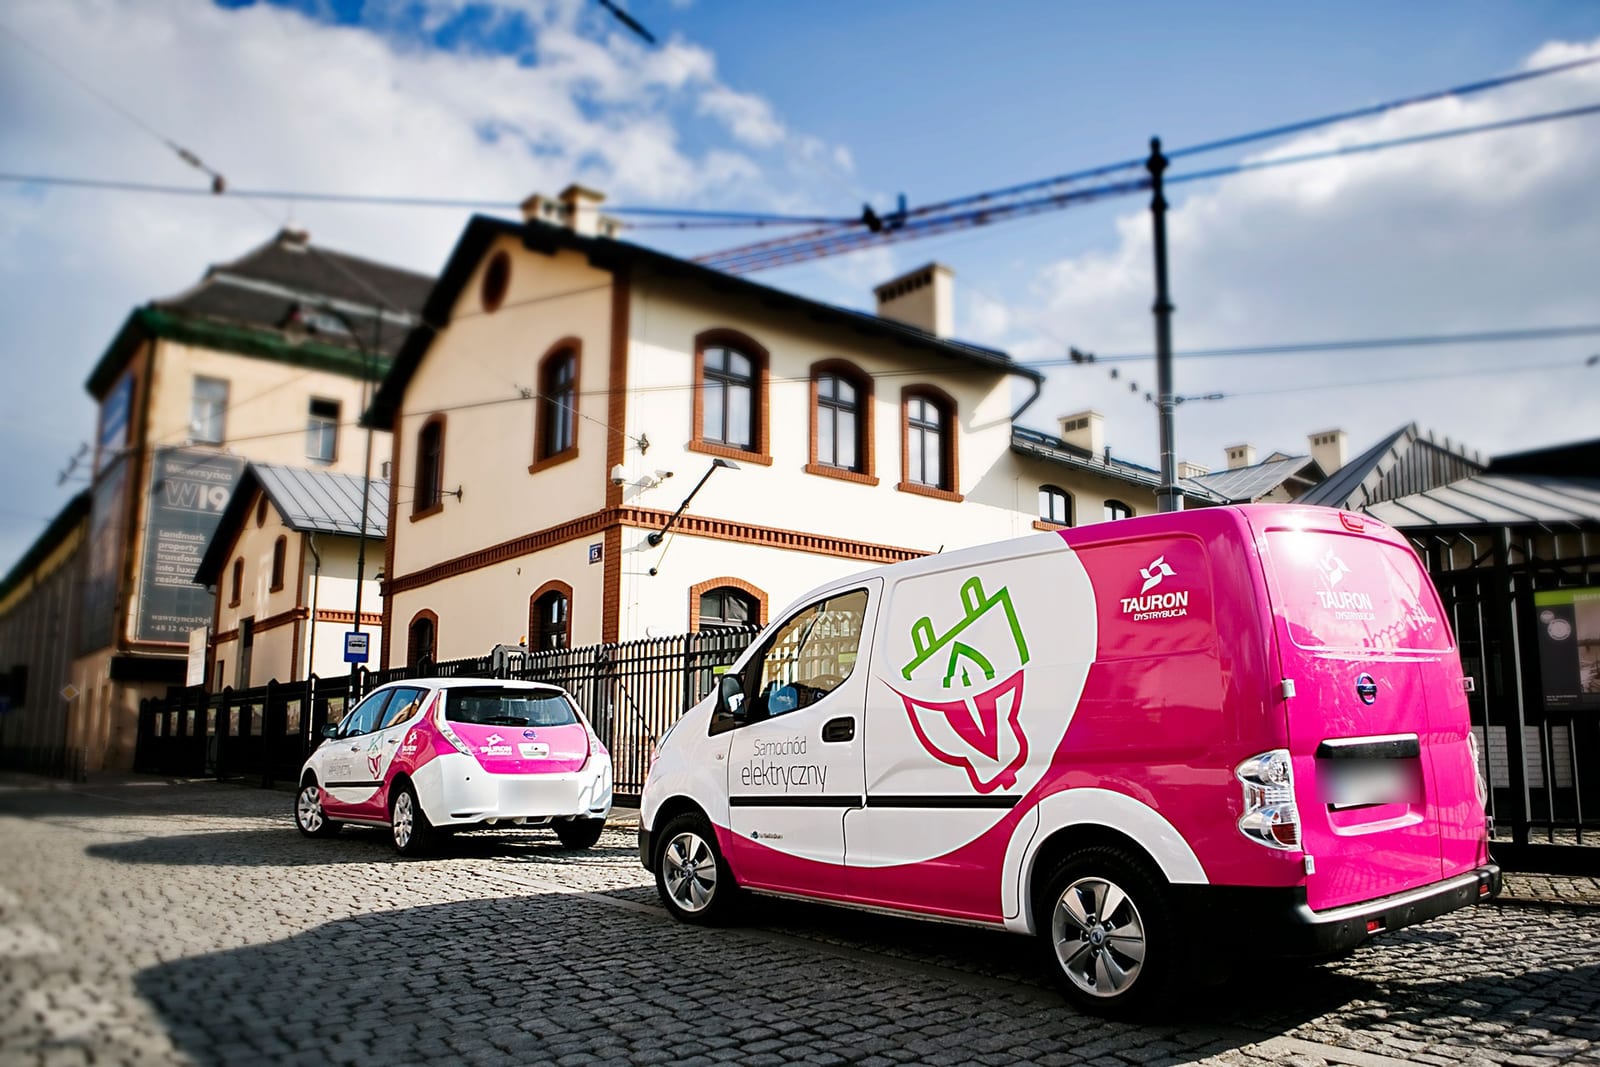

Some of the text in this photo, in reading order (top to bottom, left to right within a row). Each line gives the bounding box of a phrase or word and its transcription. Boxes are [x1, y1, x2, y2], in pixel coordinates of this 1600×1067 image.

[165, 479, 230, 512] W19
[159, 529, 206, 541] Landmark
[158, 543, 200, 554] property
[156, 553, 203, 564] transform
[156, 563, 199, 575] into luxu
[1120, 591, 1188, 613] TAURON
[1316, 592, 1372, 609] TAURON
[1133, 608, 1187, 621] DYSTRYBUCJA
[754, 736, 807, 756] Samochód
[741, 760, 827, 792] elektryczny
